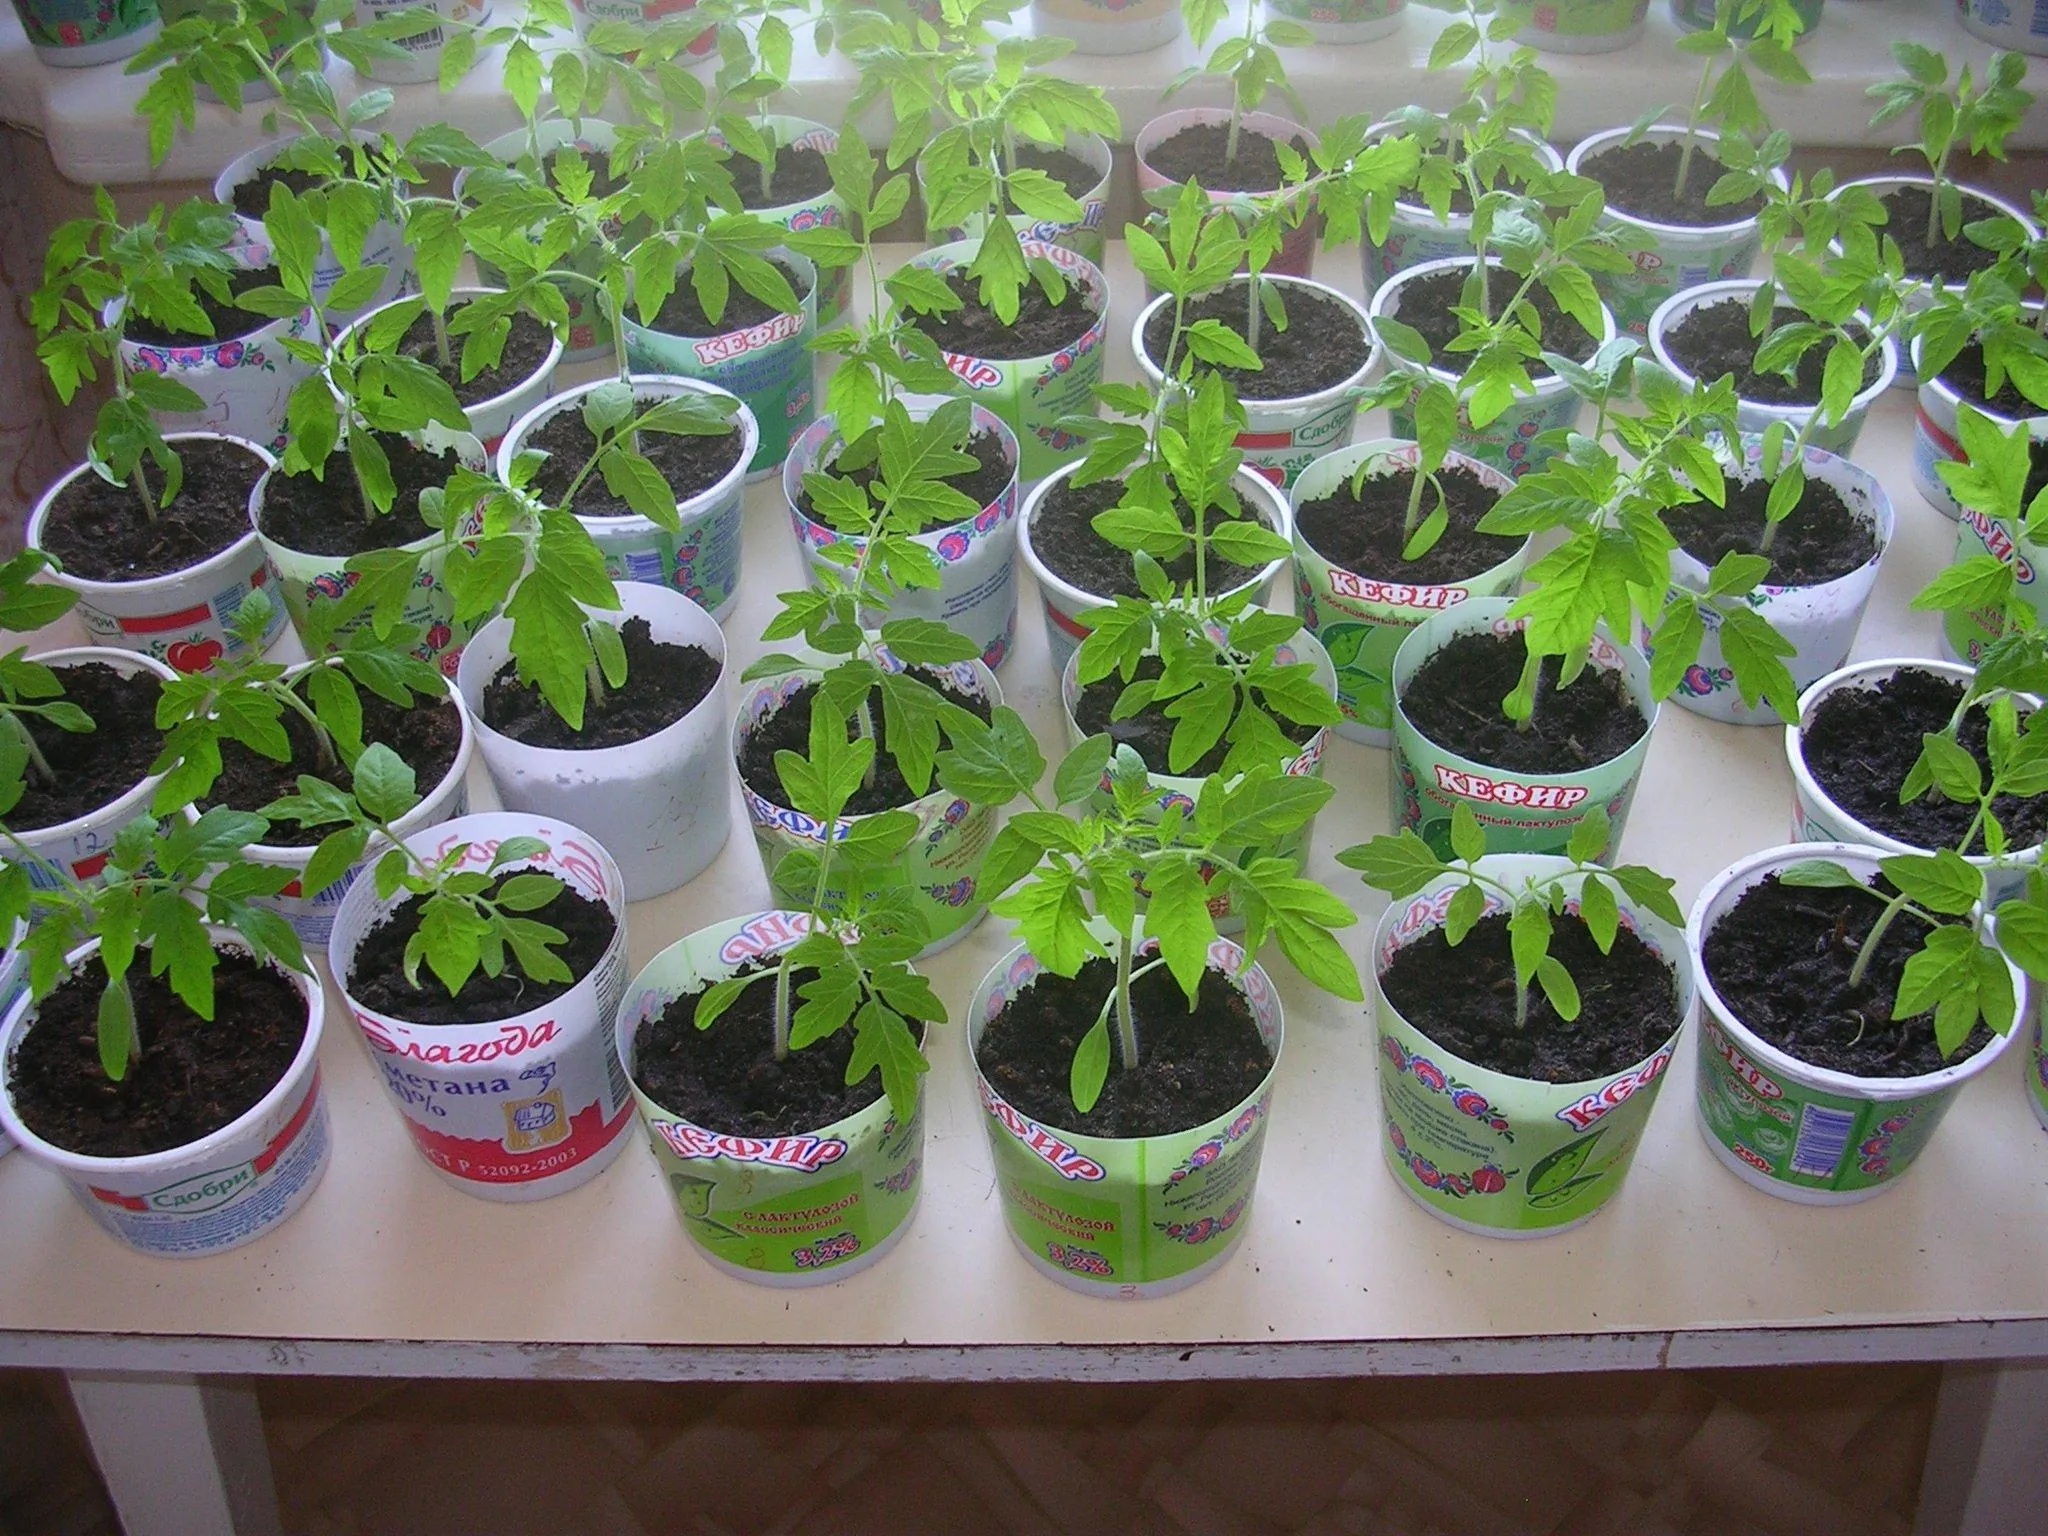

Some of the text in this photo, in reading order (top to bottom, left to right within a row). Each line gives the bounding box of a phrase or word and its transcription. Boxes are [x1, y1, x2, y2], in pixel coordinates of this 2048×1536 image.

[1328, 569, 1469, 610] КЕФИР
[1434, 764, 1589, 810] КЕФИР
[1556, 1046, 1673, 1133] КЕФ
[478, 1147, 578, 1176] 52092-2003
[651, 1119, 848, 1173] КЕФИР
[152, 1168, 249, 1208] Сдобри
